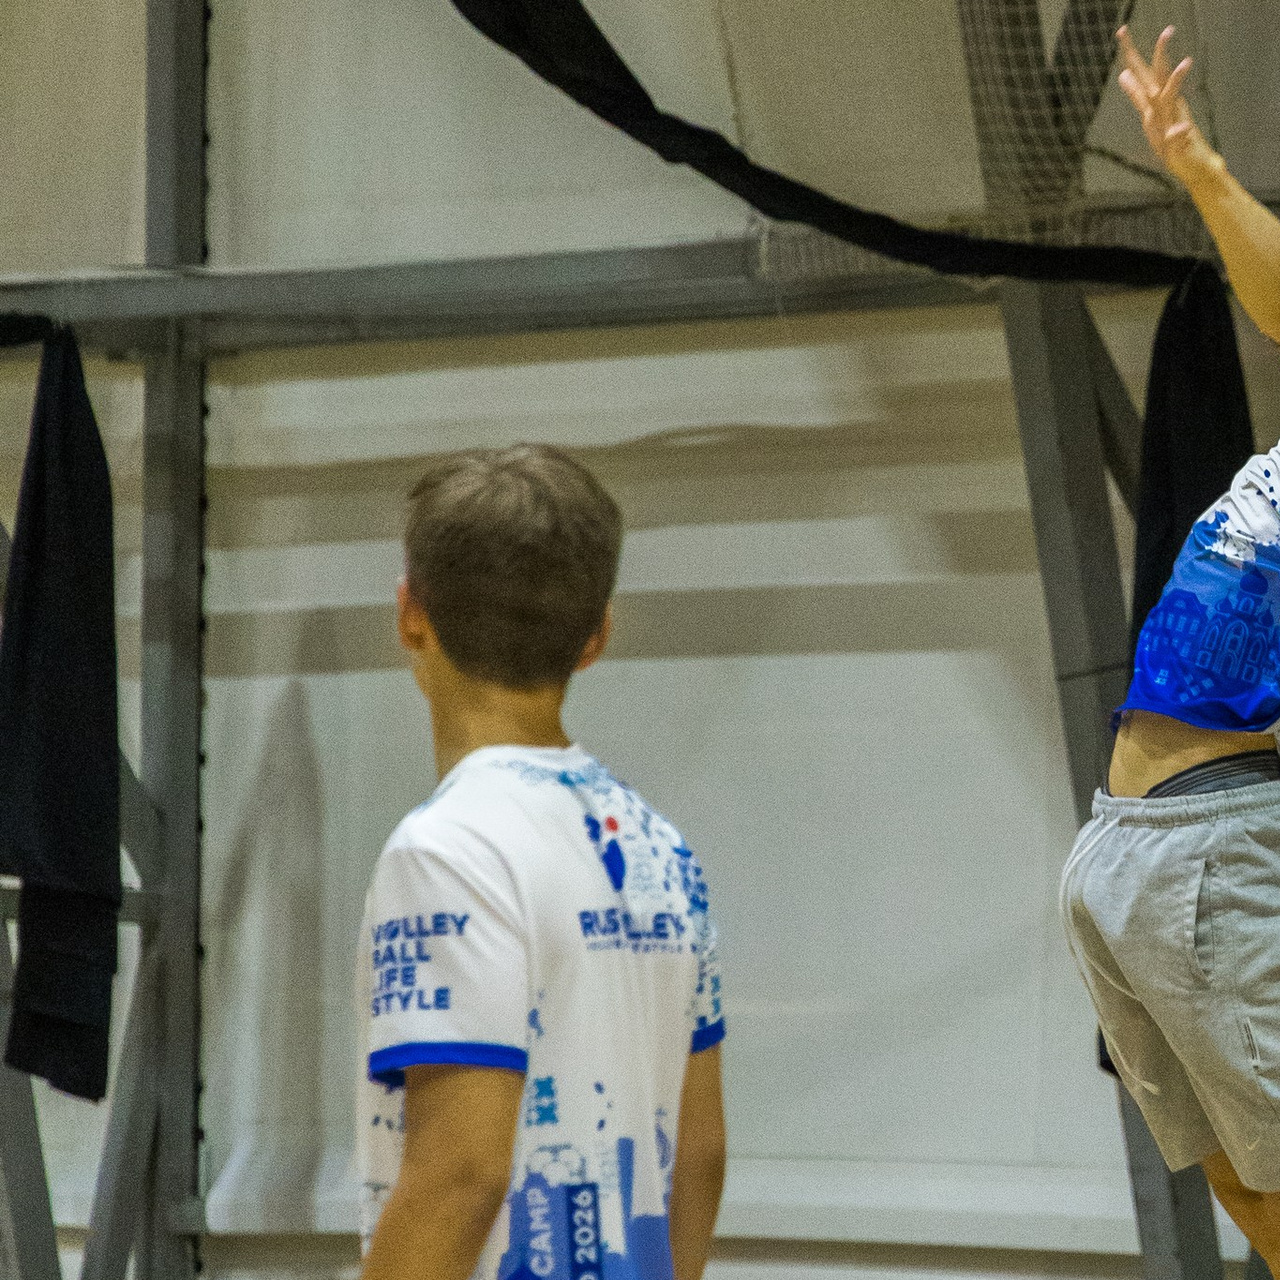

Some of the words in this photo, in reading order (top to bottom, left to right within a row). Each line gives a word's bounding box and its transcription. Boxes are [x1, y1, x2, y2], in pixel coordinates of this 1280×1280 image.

[372, 912, 469, 946] VOLLEY
[374, 965, 416, 993] IFE
[372, 986, 452, 1017] STYLE
[527, 1188, 555, 1277] CAMP
[572, 1190, 598, 1265] 2026
